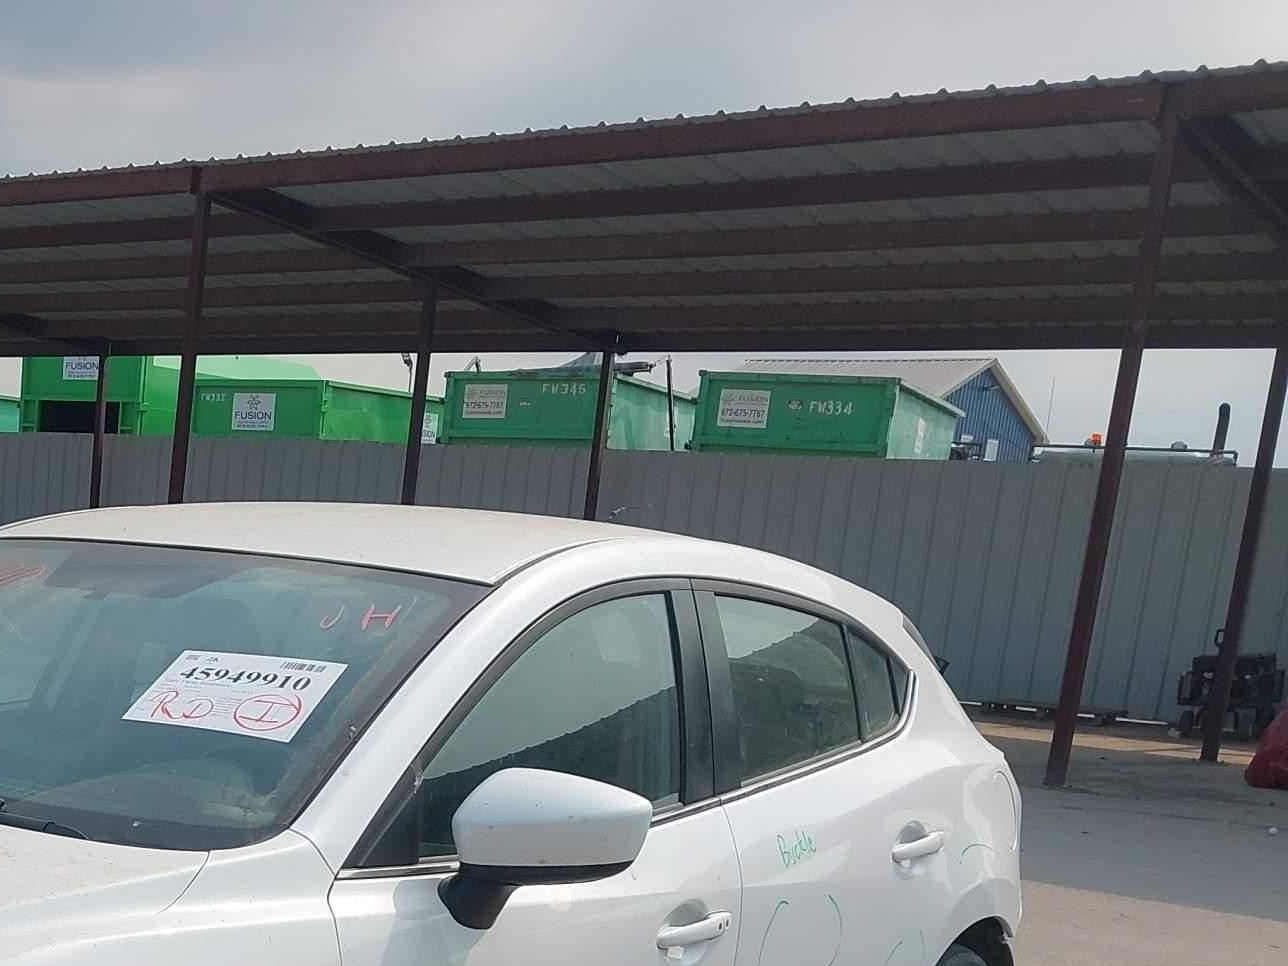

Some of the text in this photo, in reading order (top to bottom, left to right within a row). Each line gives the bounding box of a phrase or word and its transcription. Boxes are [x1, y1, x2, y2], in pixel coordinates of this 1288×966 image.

[65, 361, 99, 371] FUSION
[721, 408, 765, 418] 972-675-7767
[809, 400, 853, 416] FW334
[235, 411, 272, 420] FUSION
[180, 666, 312, 692] 45949910
